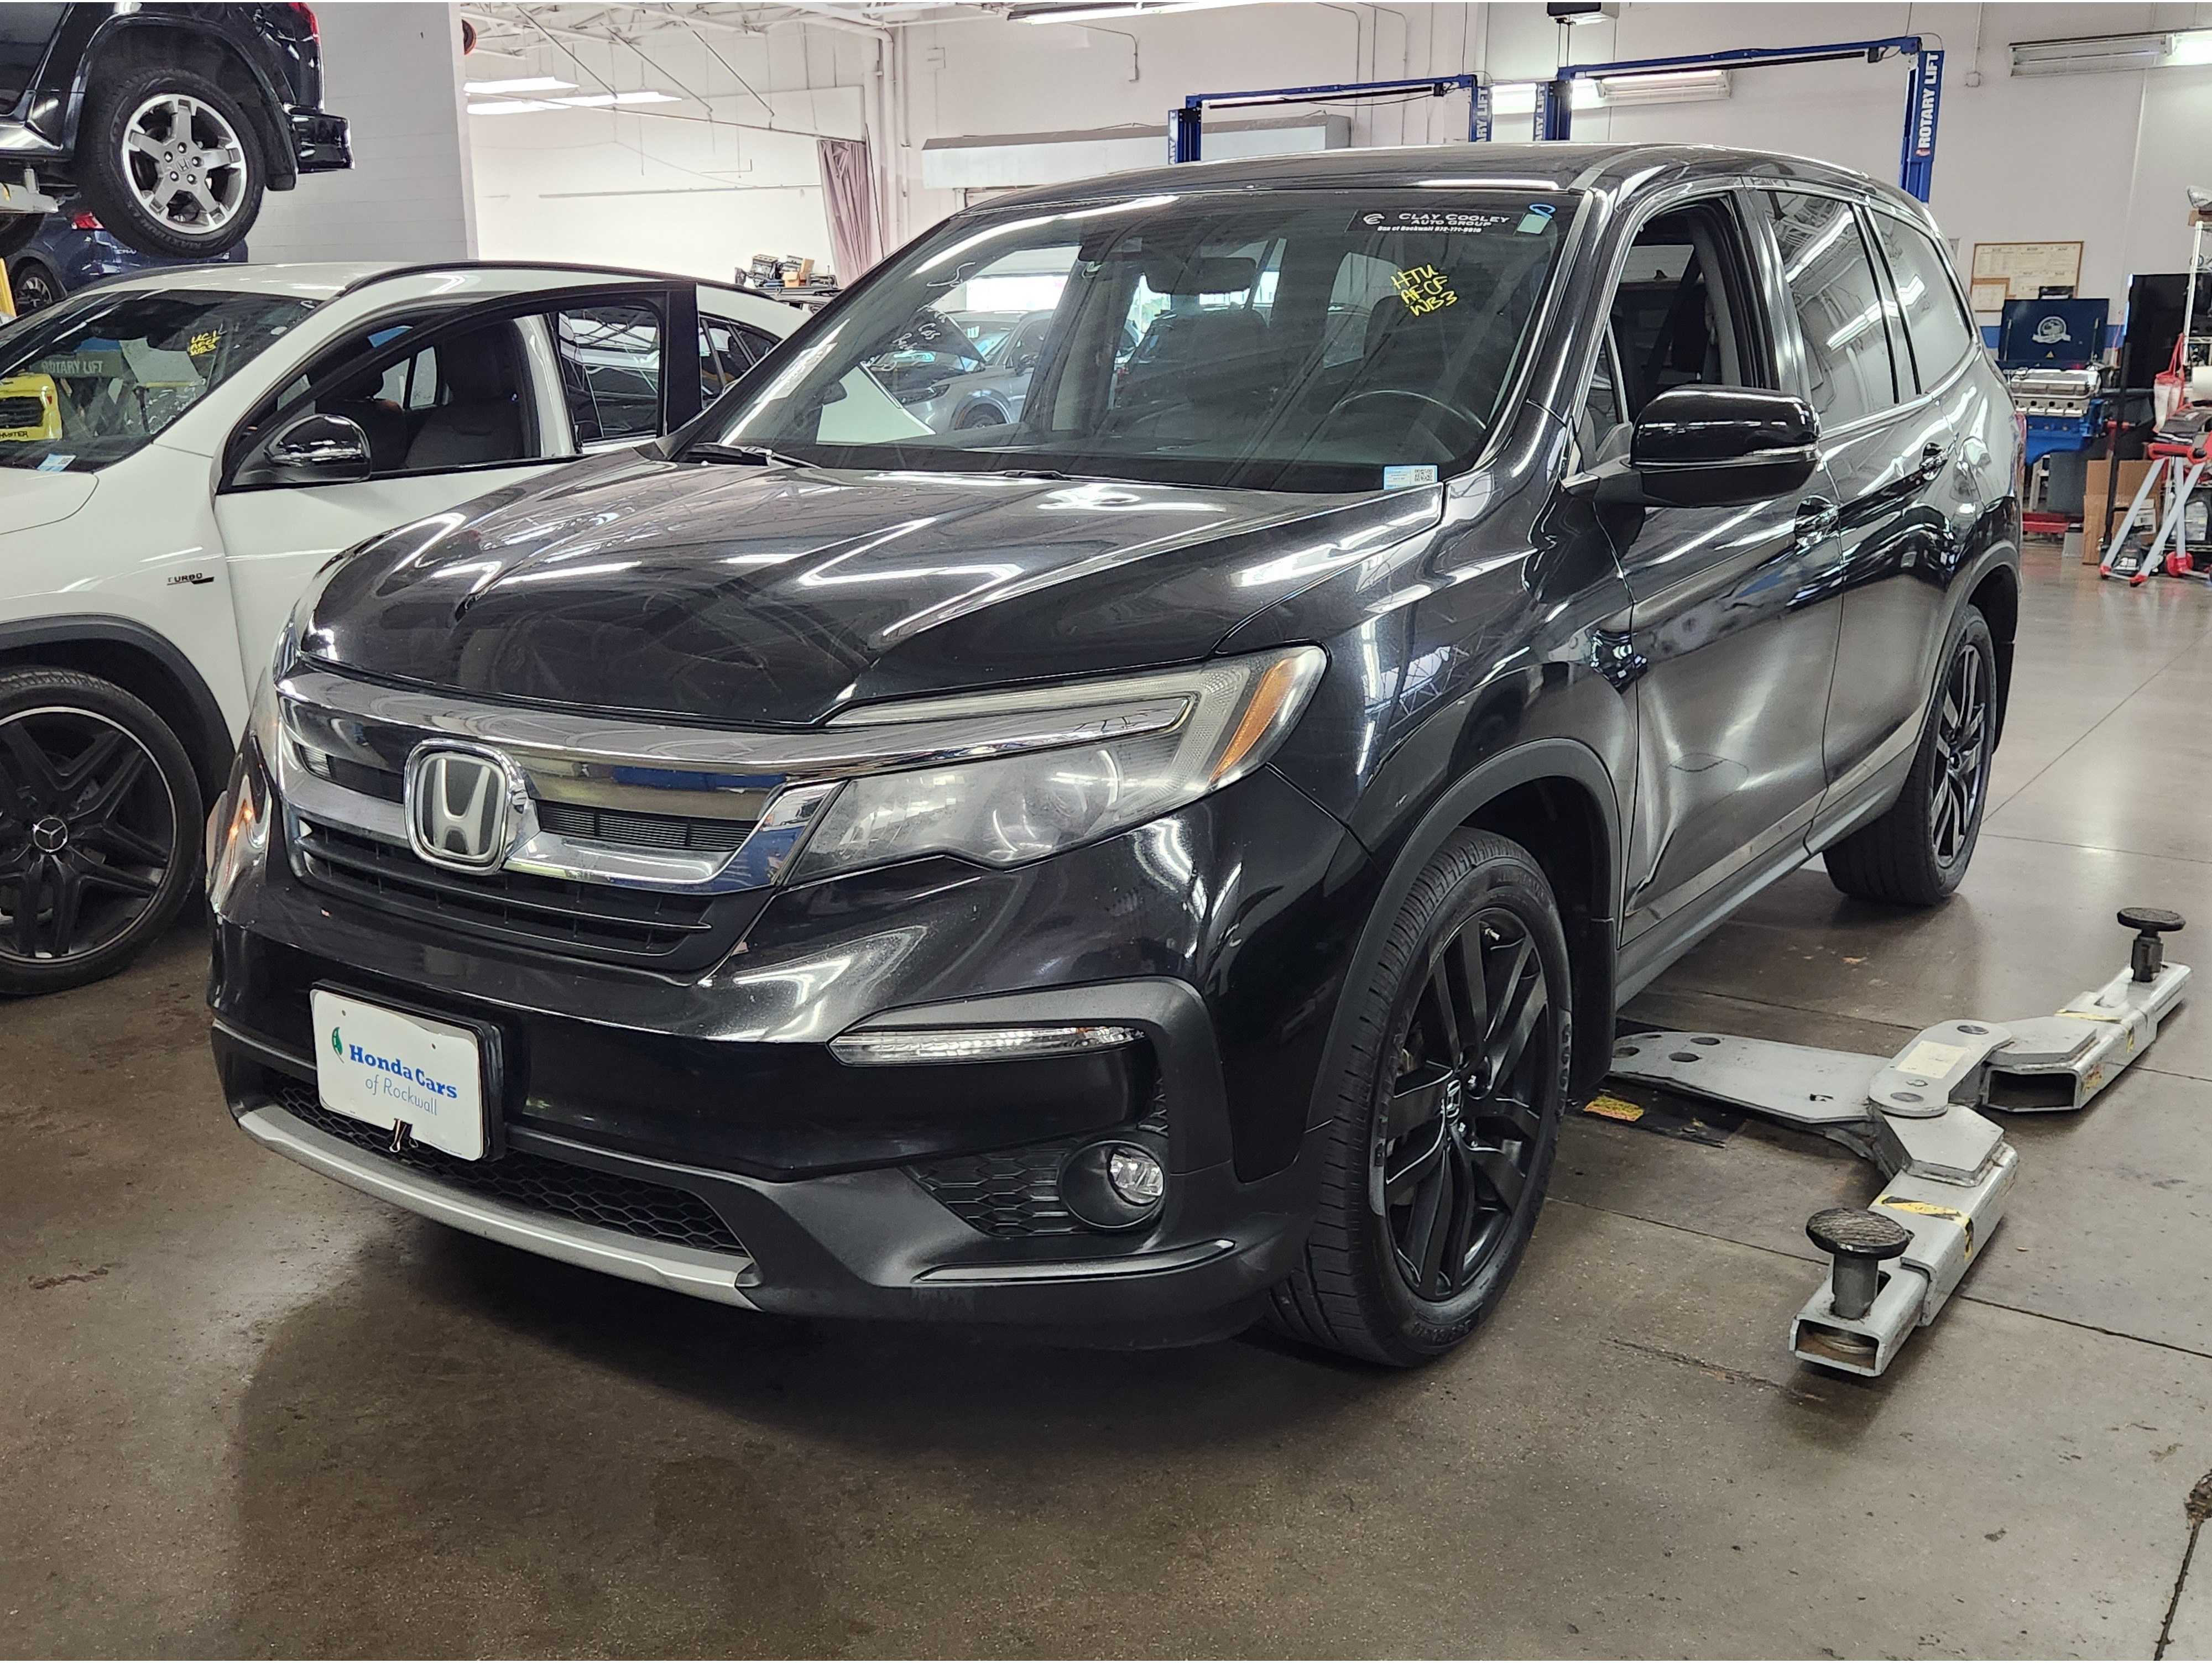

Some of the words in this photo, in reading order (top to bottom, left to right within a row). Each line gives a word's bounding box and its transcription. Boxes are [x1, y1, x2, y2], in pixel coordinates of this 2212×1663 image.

[1924, 53, 1939, 85] LIFT
[1477, 87, 1488, 117] LIFT
[1536, 84, 1546, 113] LIFT
[1476, 119, 1488, 142] ARY
[1535, 116, 1544, 142] ARY
[1917, 87, 1936, 148] ROTARY
[1444, 213, 1510, 223] COOLEY
[1410, 290, 1458, 317] WB3
[41, 360, 81, 374] ROTARY
[84, 360, 103, 374] LIFT
[168, 573, 202, 582] TURBO
[348, 1043, 414, 1081] Honda
[415, 1068, 458, 1099] Cars
[365, 1074, 380, 1096] of
[383, 1077, 438, 1116] Rockwall
